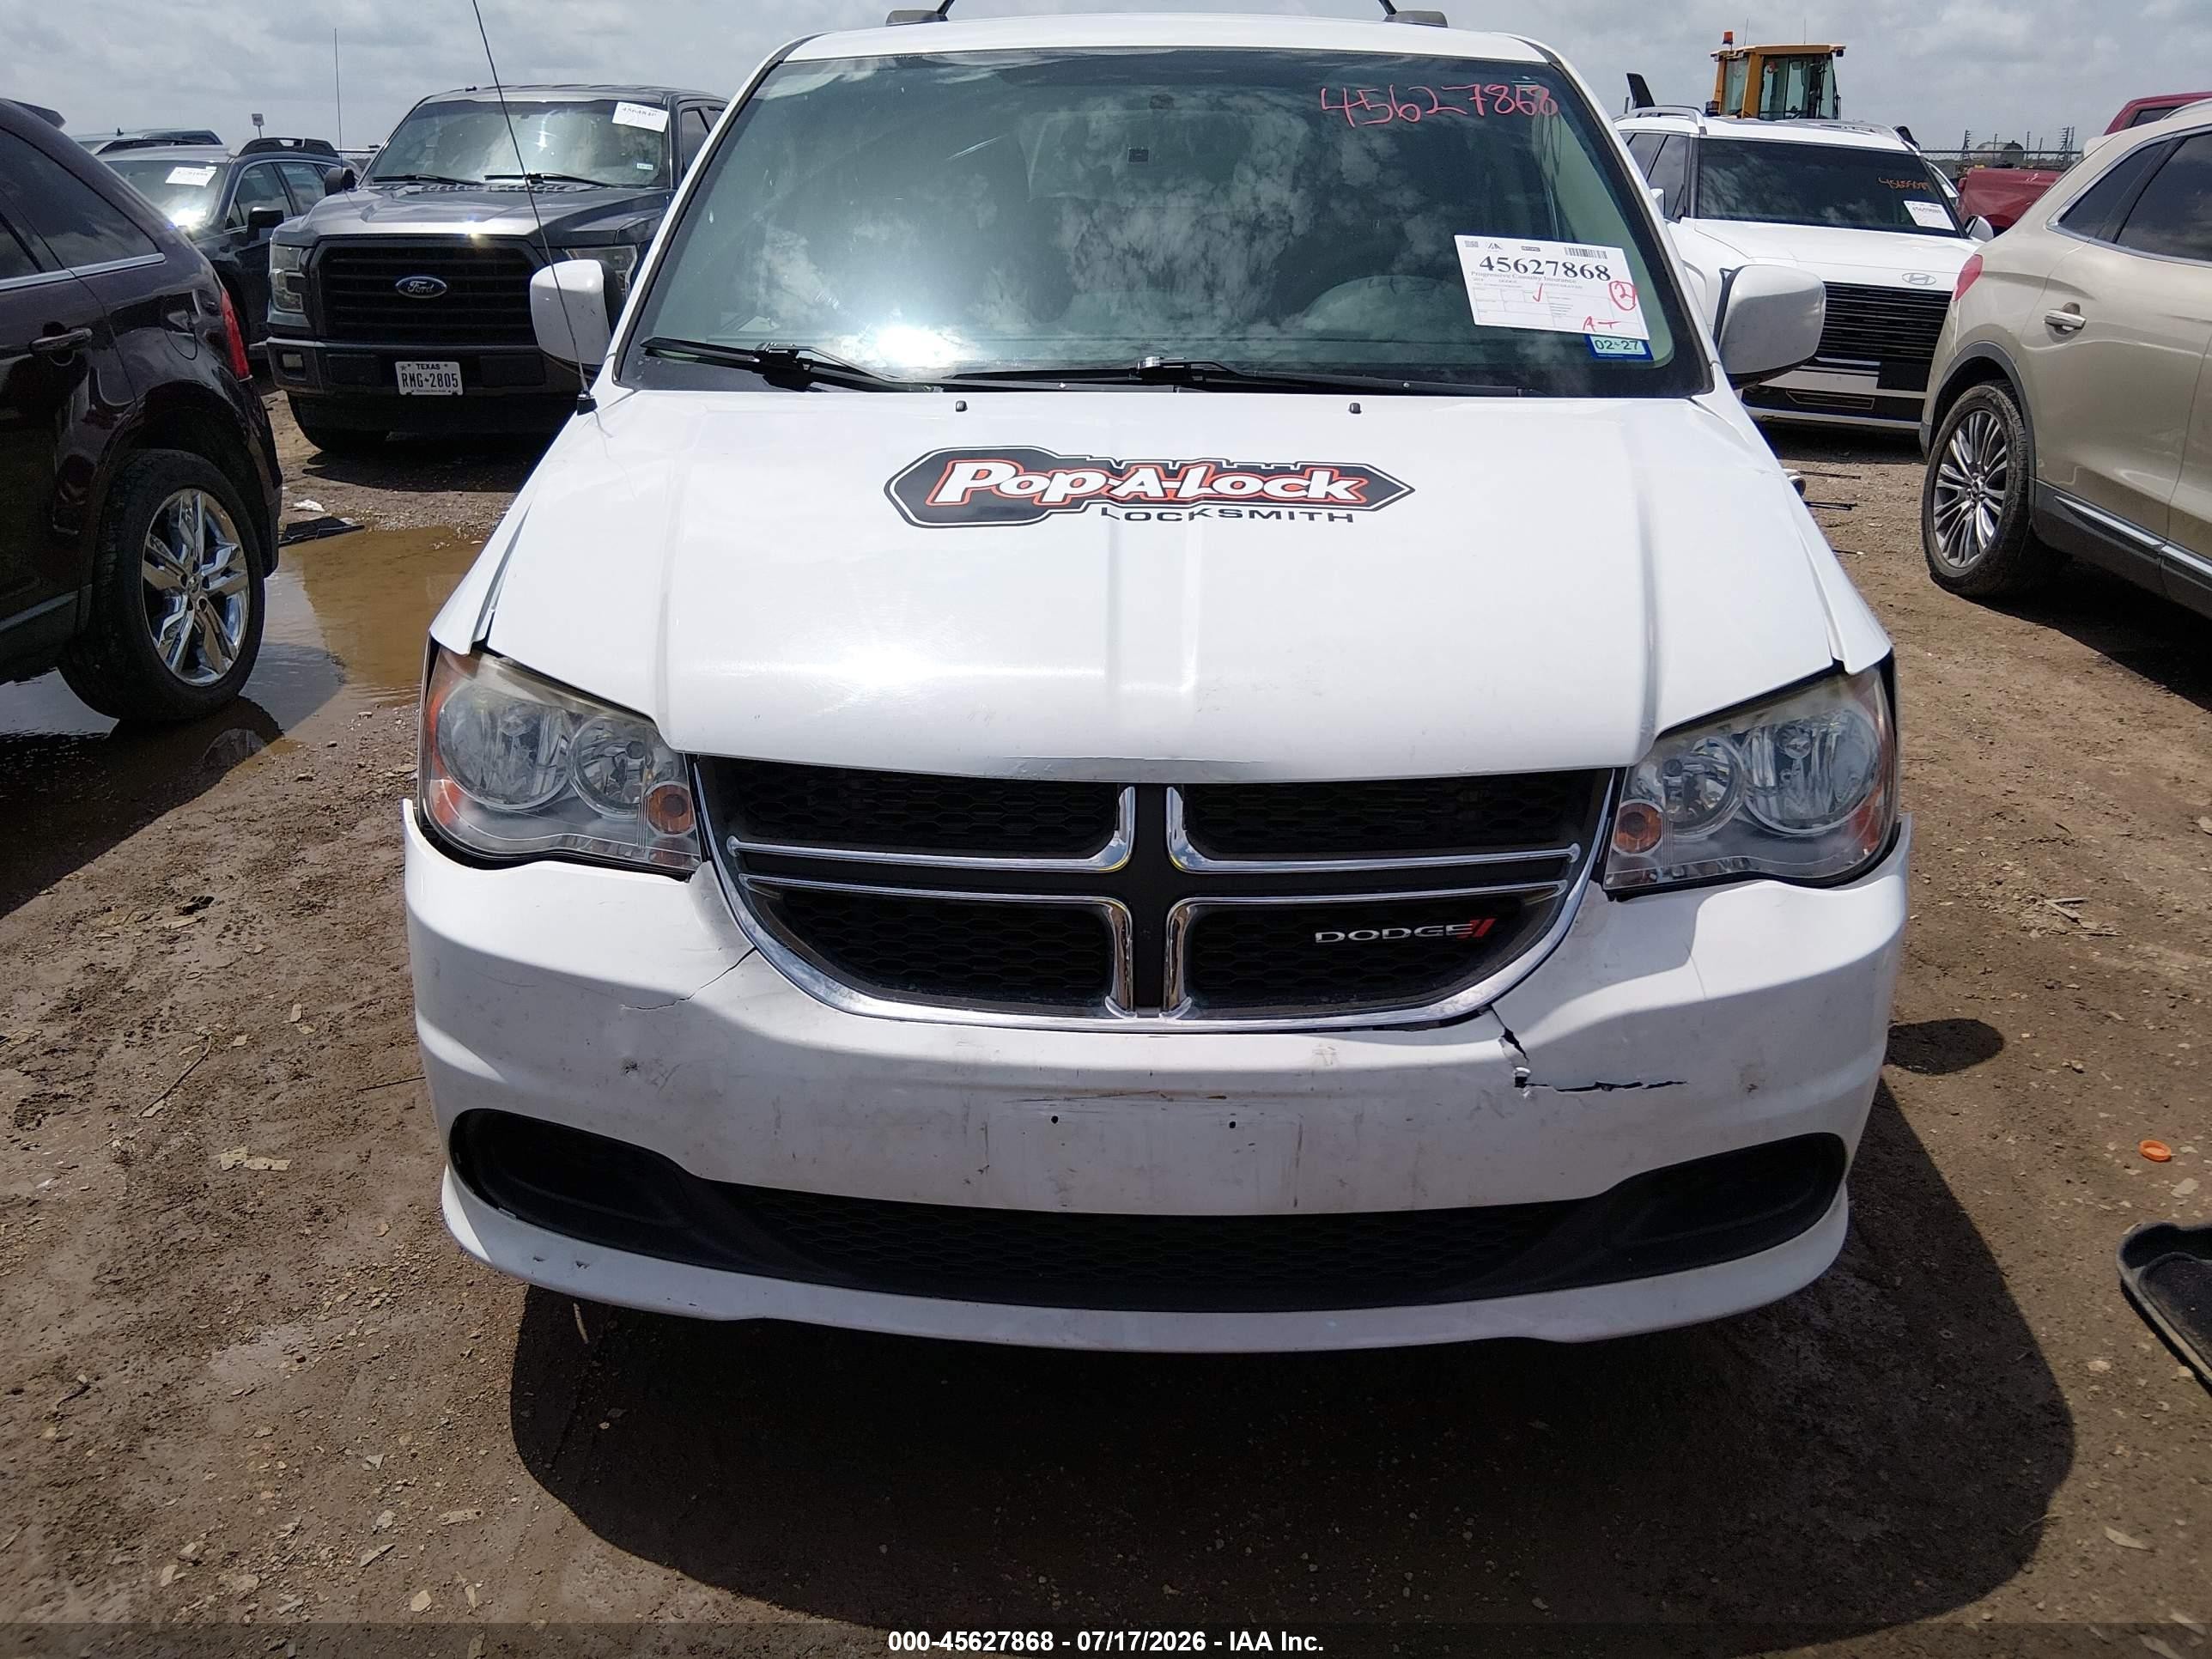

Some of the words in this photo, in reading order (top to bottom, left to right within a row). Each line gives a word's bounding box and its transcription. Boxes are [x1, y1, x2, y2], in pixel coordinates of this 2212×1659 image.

[1479, 256, 1611, 282] 45627868
[407, 280, 435, 293] Ford
[1101, 507, 1354, 523] LOCKSMITH
[1315, 923, 1474, 943] DODGE
